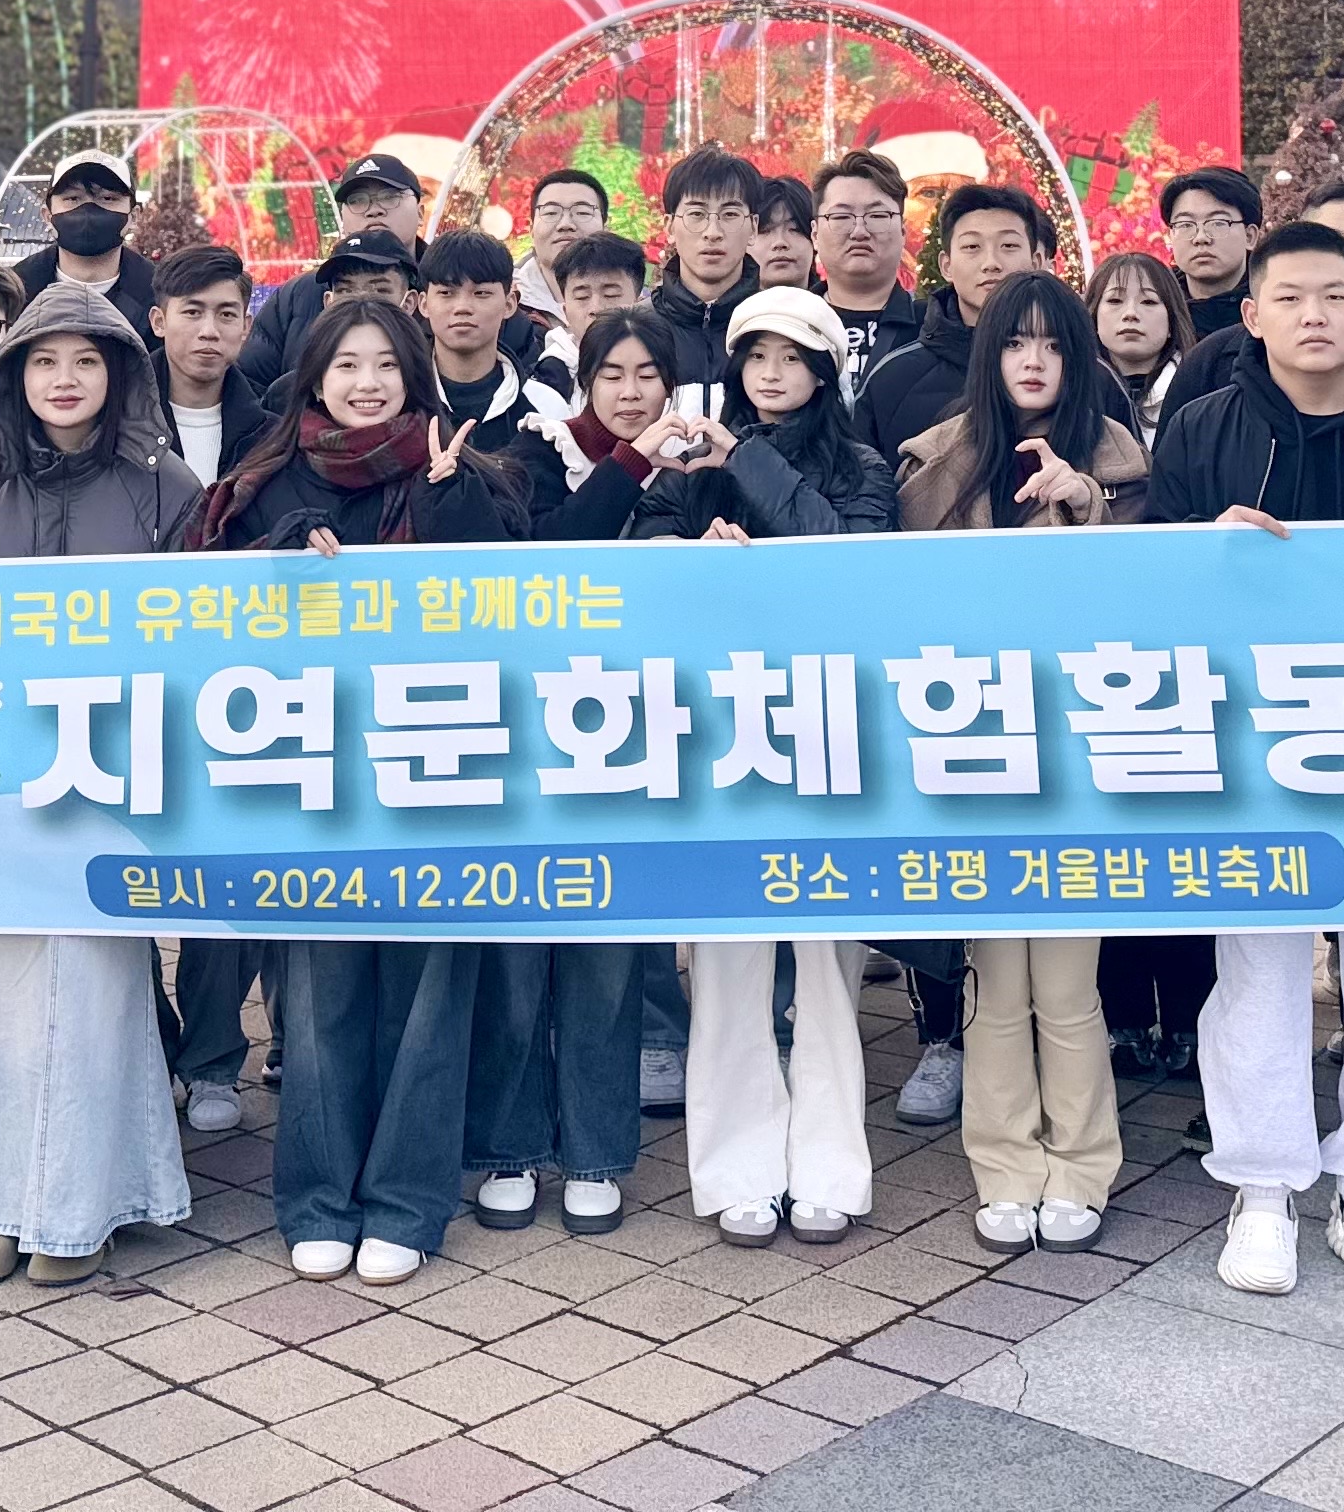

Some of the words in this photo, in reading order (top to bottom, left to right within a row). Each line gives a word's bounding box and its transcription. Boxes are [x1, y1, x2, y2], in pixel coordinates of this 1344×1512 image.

[135, 580, 400, 642] 유학생들과
[416, 574, 624, 635] 함께하는
[122, 864, 205, 910] 일시
[252, 854, 613, 911] 2024.12.20.(금)
[759, 852, 849, 904] 장소
[898, 849, 989, 901] 함평
[1010, 848, 1150, 901] 겨울밤
[1167, 845, 1310, 899] 빛축제
